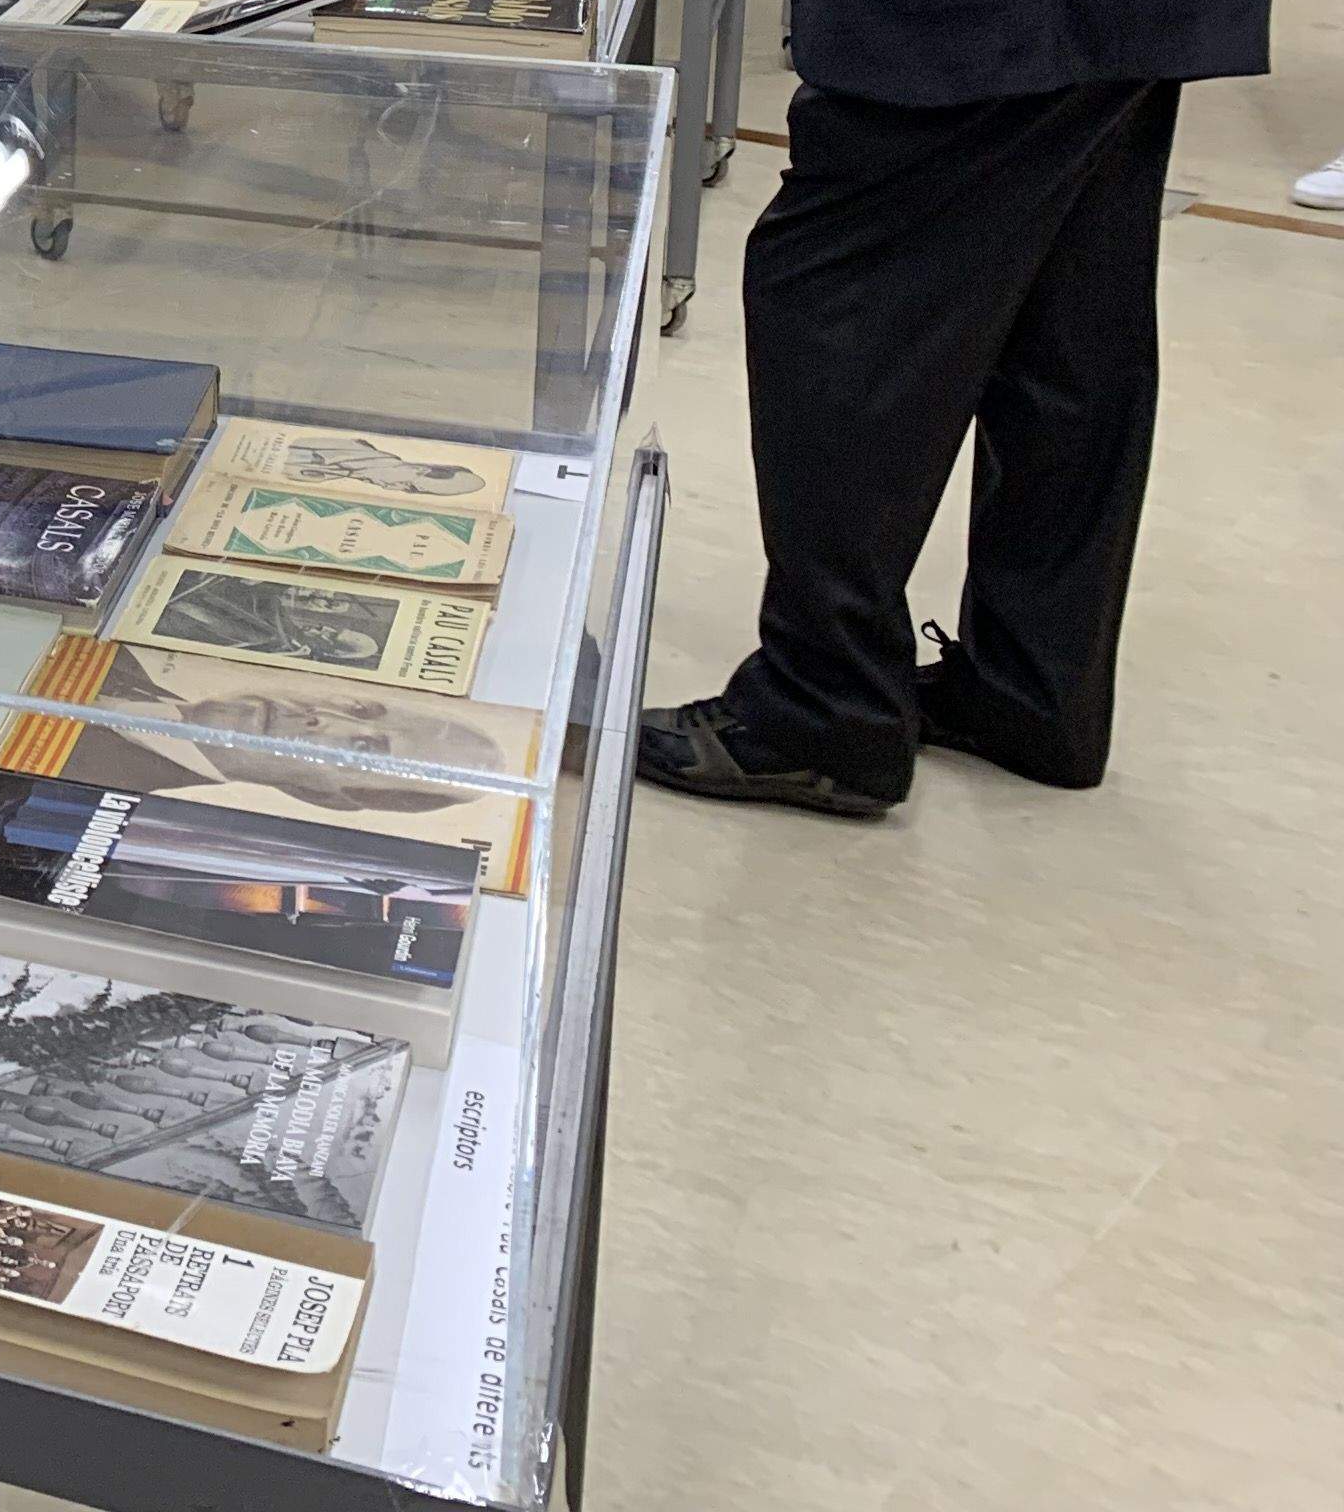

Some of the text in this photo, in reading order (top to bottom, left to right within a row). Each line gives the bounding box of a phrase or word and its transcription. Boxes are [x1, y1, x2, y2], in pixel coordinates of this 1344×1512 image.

[33, 482, 108, 555] CASALS
[416, 602, 474, 684] PAU CASALS
[45, 791, 141, 907] La violoncelliste
[239, 1048, 297, 1169] DE LA MEMÒRIA
[269, 1045, 331, 1184] LA MELODIA BLAVA
[320, 1103, 342, 1134] SOLER
[453, 1090, 485, 1172] escriptors
[96, 1228, 135, 1277] Una tria
[100, 1234, 160, 1319] PASSAPORT
[159, 1240, 187, 1266] DE
[163, 1246, 214, 1319] RETRATS
[221, 1254, 255, 1270] 1
[237, 1310, 271, 1356] SELECTES
[276, 1275, 334, 1367] JOSEP PLA
